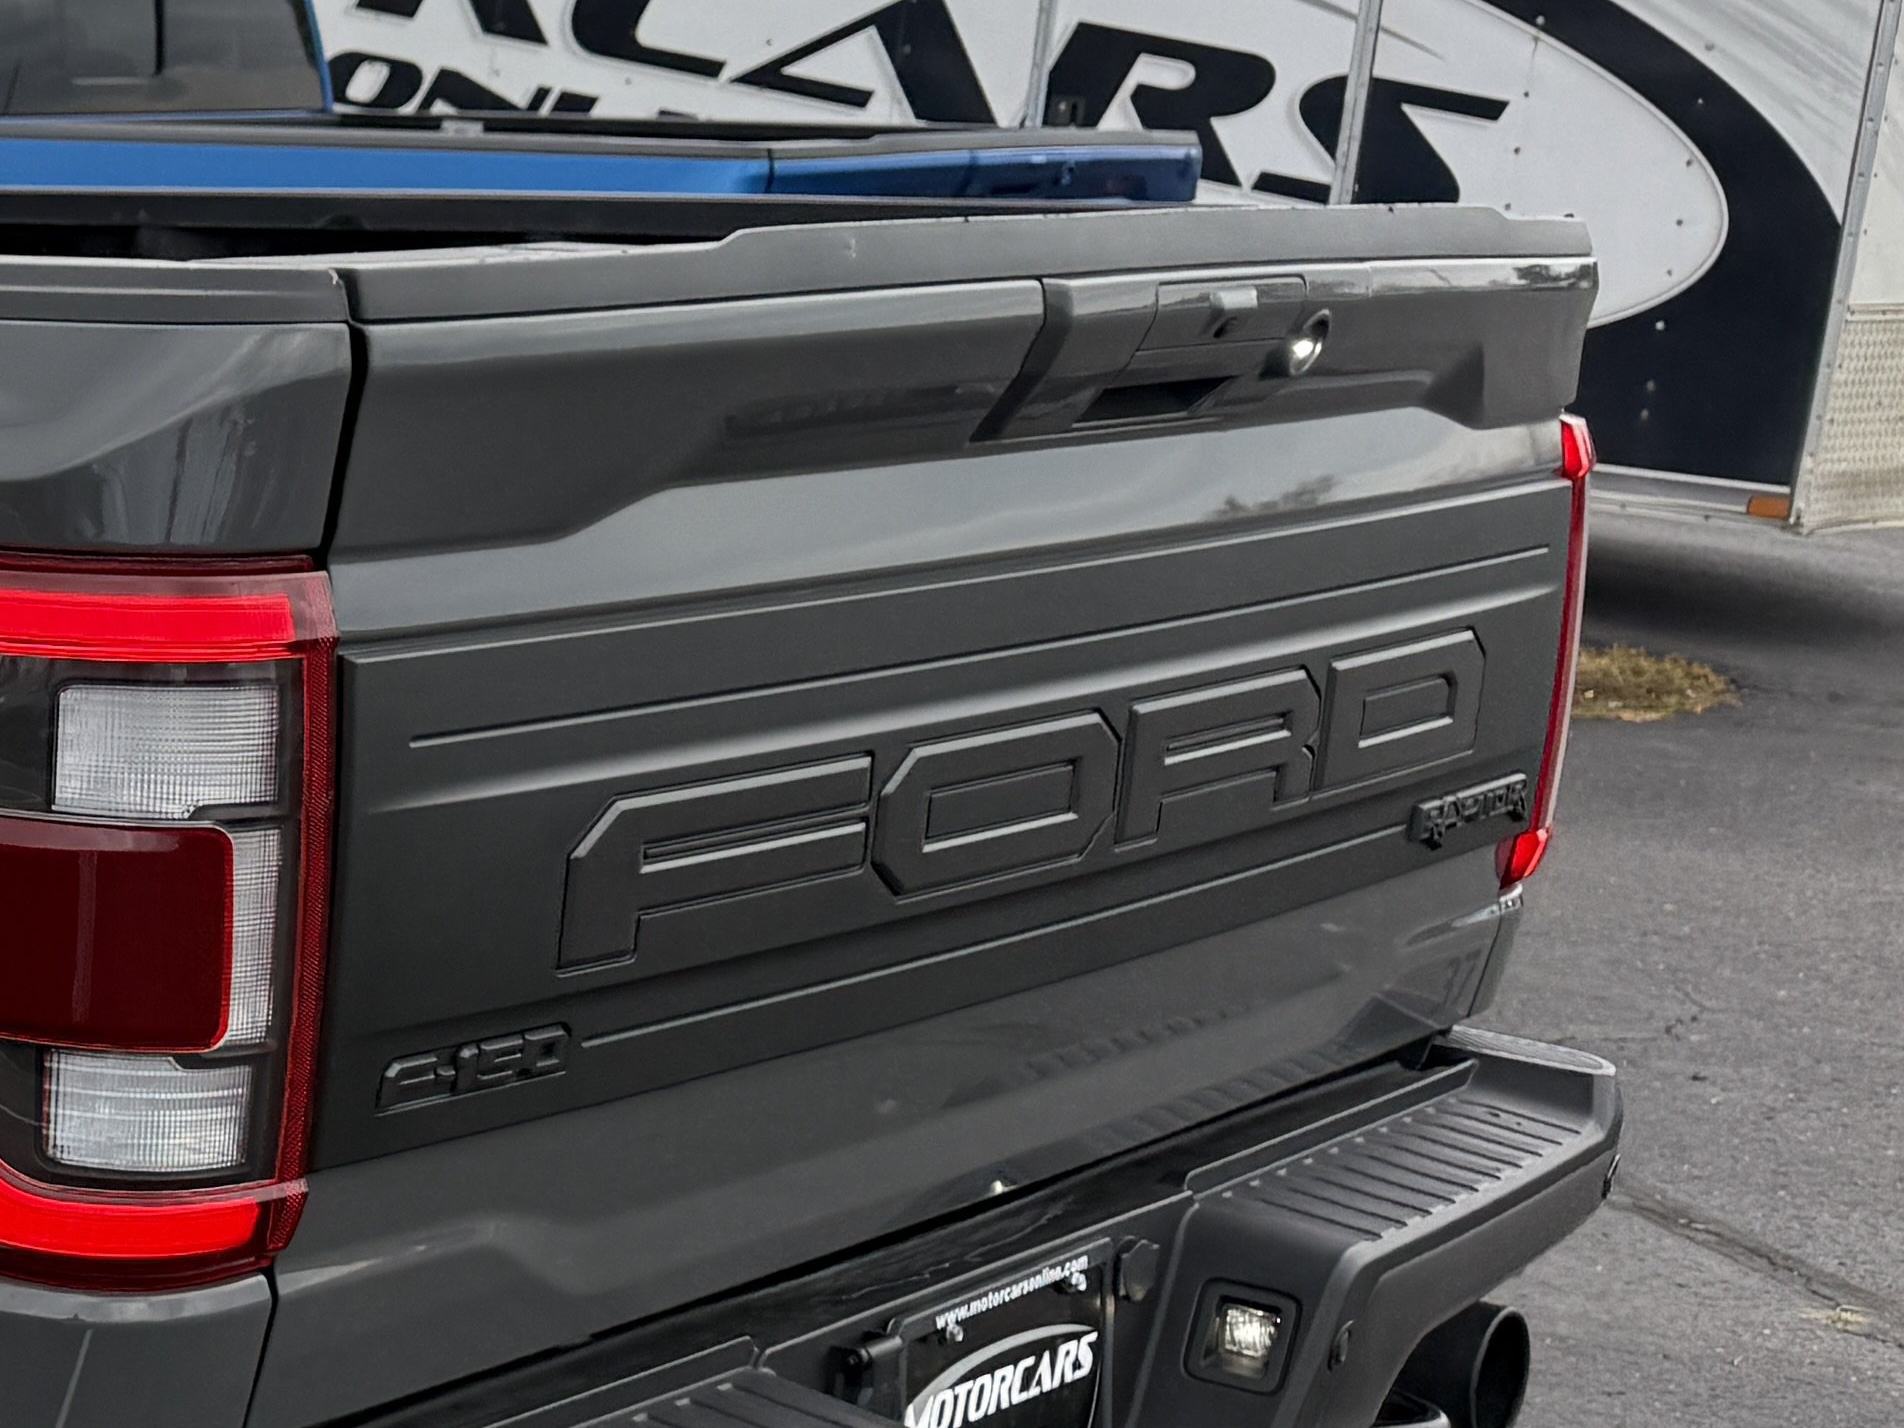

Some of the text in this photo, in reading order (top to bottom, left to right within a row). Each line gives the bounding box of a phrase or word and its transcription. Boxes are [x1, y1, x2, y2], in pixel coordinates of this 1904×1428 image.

[557, 626, 1487, 972] FORD
[1406, 771, 1529, 851] RAPTOR
[375, 1022, 571, 1112] F-150
[935, 1254, 1090, 1332] www.motorcarsonline.com
